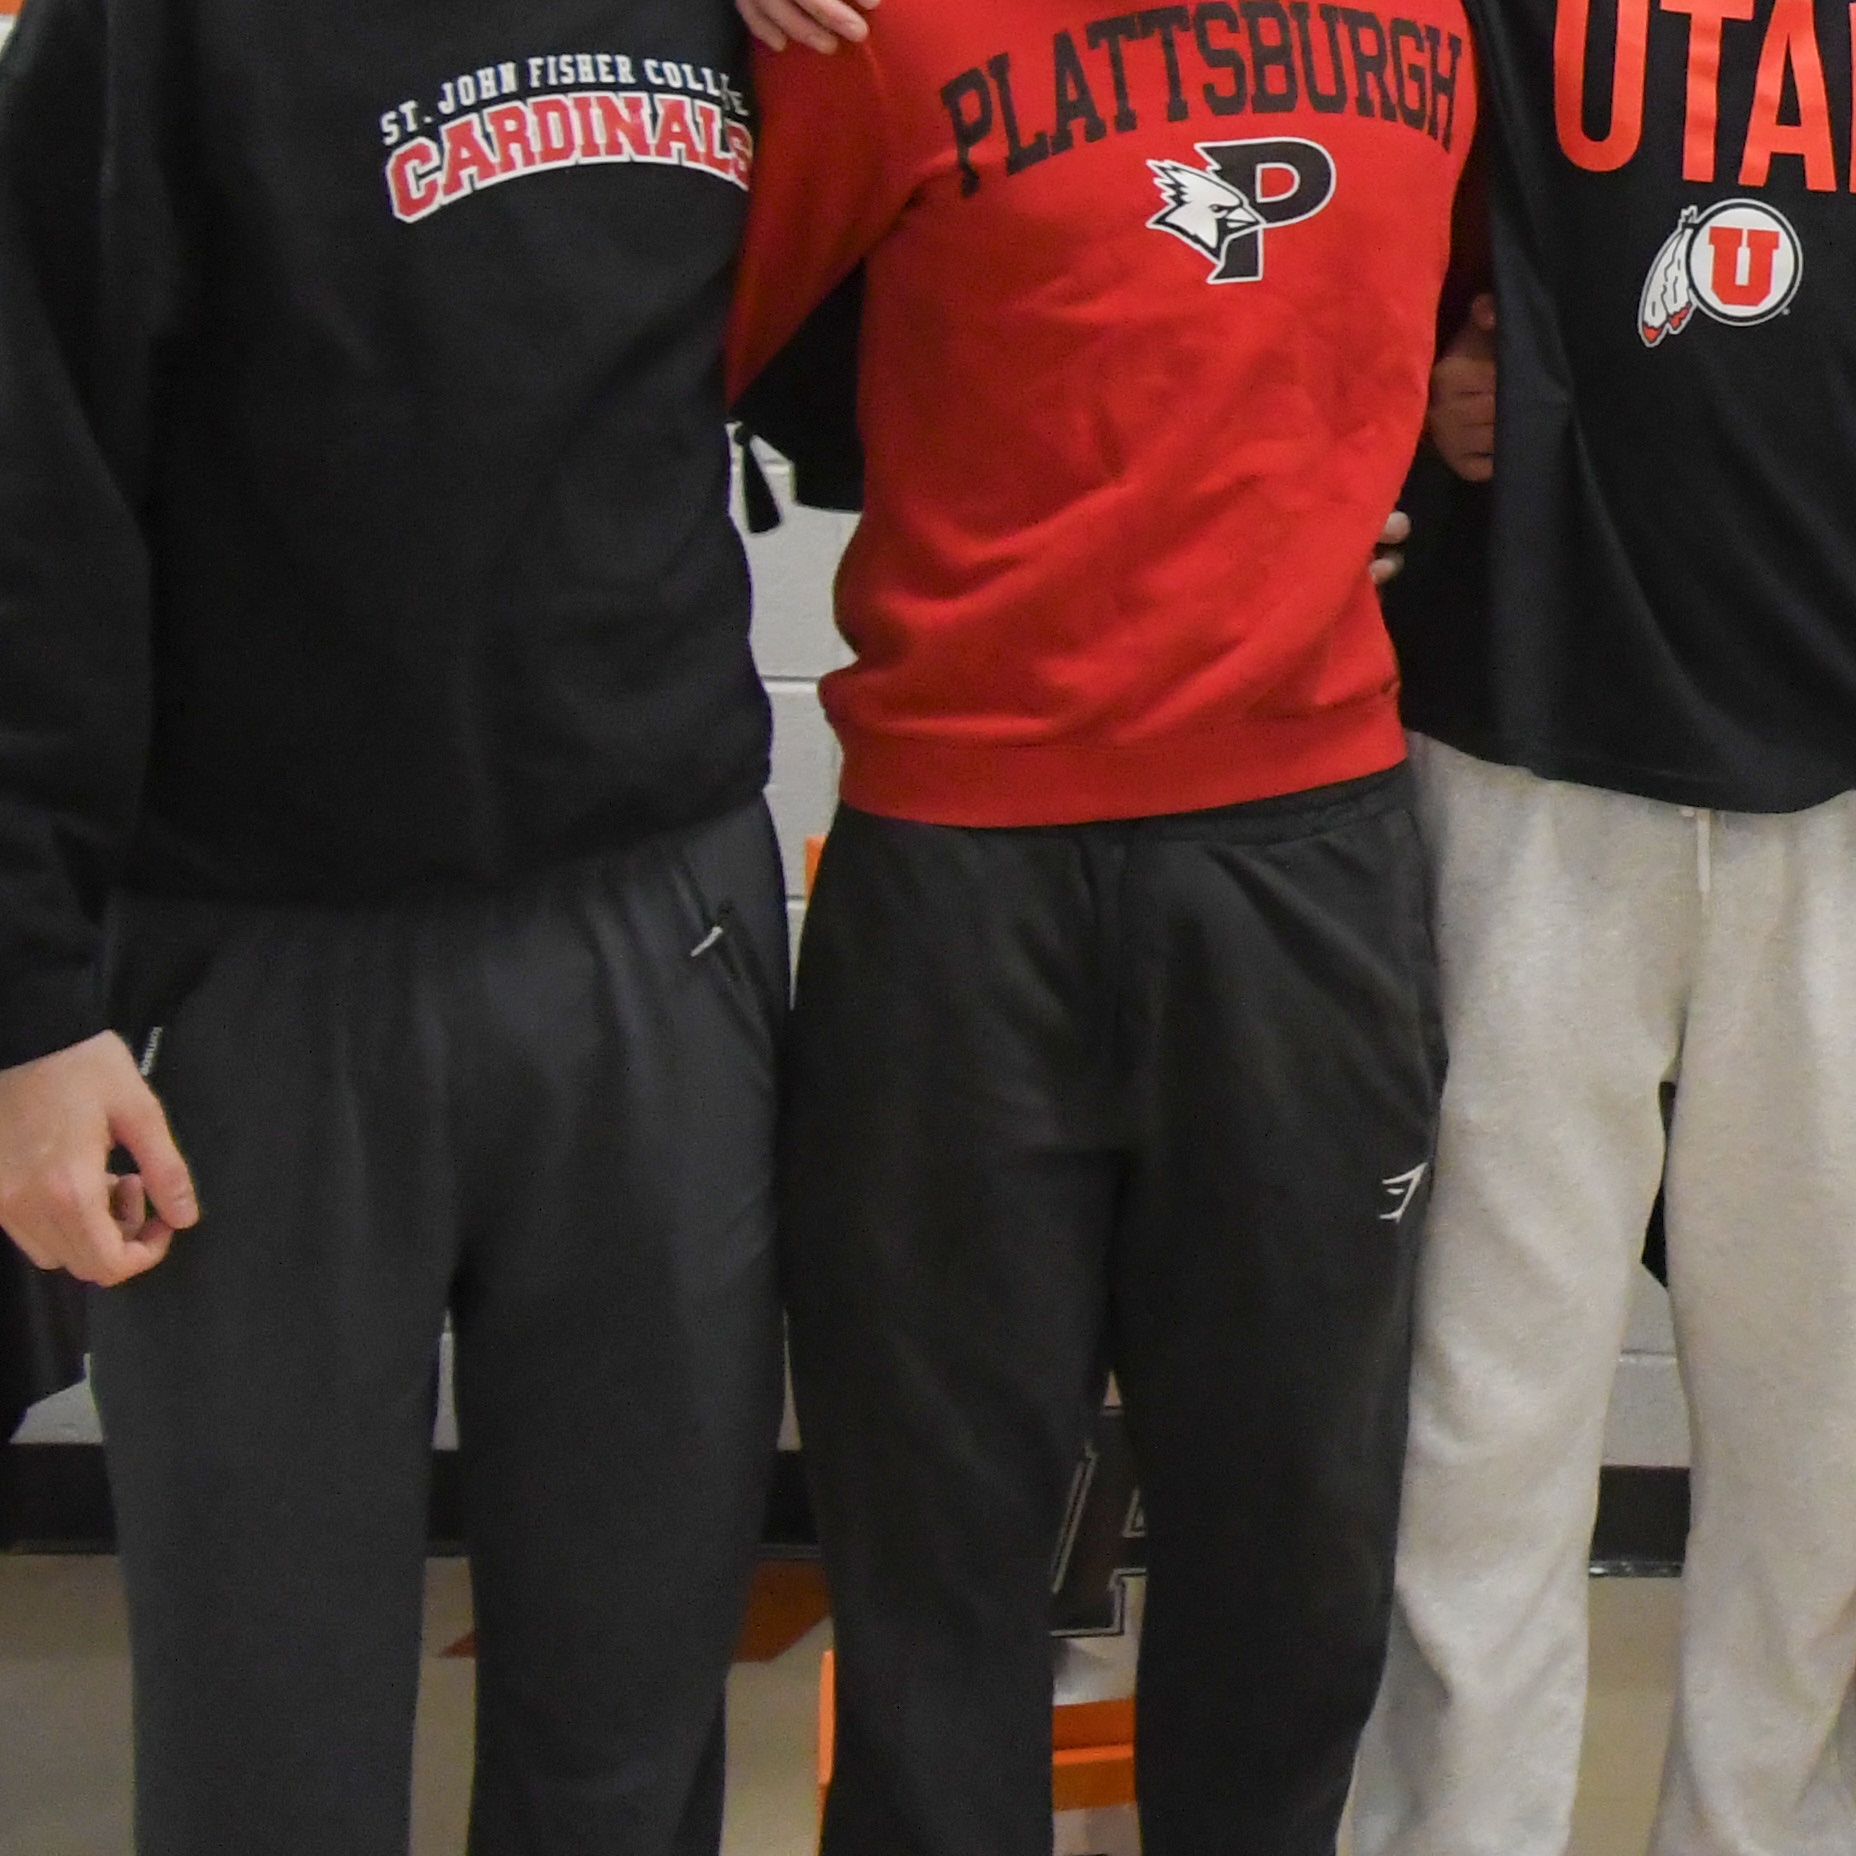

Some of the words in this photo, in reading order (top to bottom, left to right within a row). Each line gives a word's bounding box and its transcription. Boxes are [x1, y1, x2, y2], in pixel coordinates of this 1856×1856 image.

[380, 100, 432, 145] ST.
[438, 62, 518, 115] JOHN
[527, 53, 637, 88] FISHER
[385, 91, 754, 224] CARDINALS
[940, 0, 1463, 198] PLATTSBURGH
